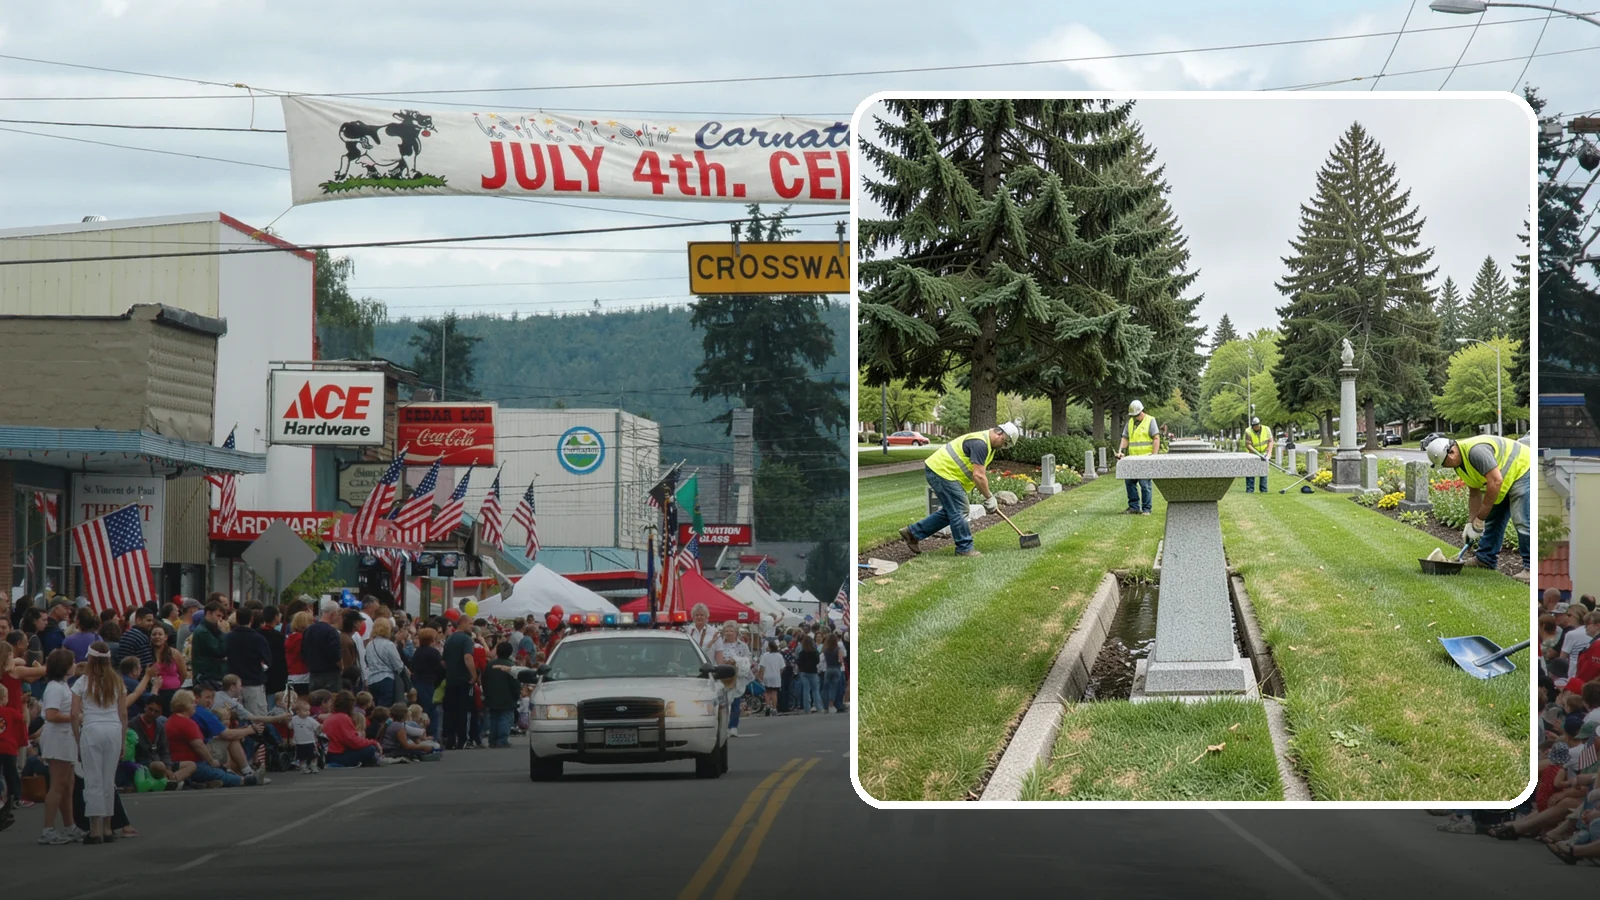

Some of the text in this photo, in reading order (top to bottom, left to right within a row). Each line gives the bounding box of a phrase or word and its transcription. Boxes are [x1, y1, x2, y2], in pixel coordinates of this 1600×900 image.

[695, 121, 850, 150] Carnat
[481, 140, 605, 192] JULY
[632, 150, 747, 197] 4th.
[696, 254, 850, 280] CROSSWA
[283, 380, 373, 419] ACE
[405, 408, 452, 422] CEDAR
[283, 421, 371, 437] Hardware
[353, 467, 386, 482] Simpl
[96, 485, 124, 494] Vincent
[126, 486, 135, 494] de
[138, 486, 155, 495] Paul
[688, 526, 741, 535] CRNATION
[699, 535, 730, 543] GLASS
